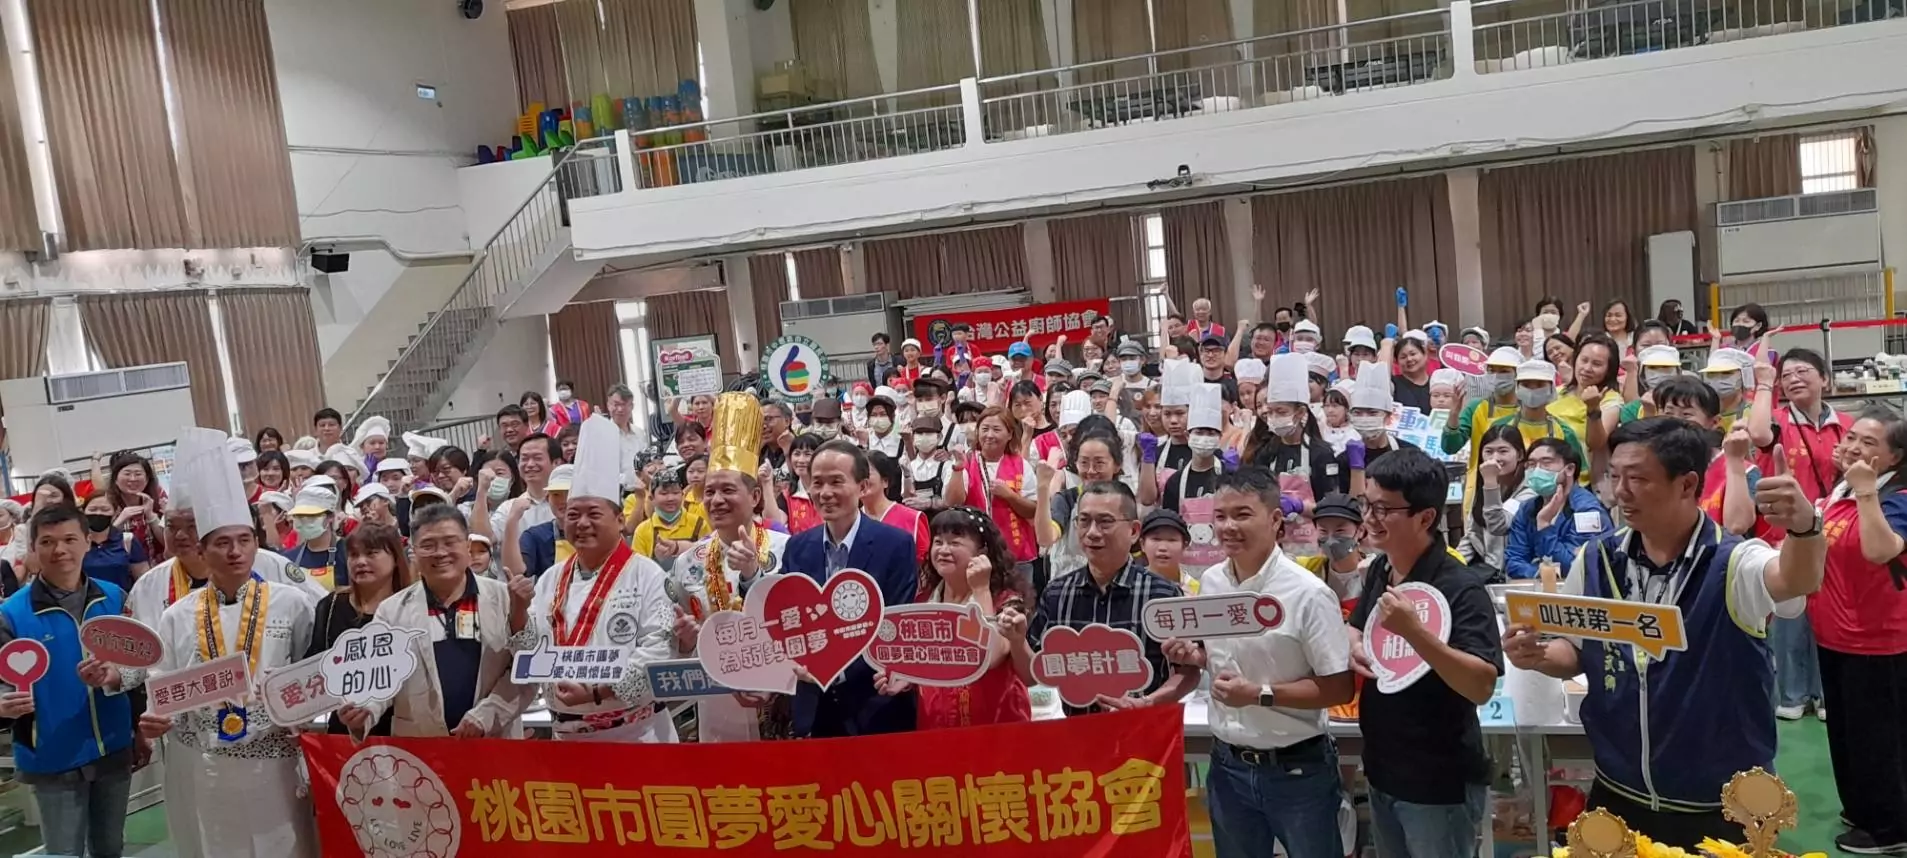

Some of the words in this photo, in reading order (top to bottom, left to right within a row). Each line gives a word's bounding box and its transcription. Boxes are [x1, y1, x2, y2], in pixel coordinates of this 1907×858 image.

[715, 605, 802, 646] 每月一愛
[900, 619, 953, 642] 桃園市
[1154, 602, 1250, 631] 每月一愛
[1538, 603, 1664, 640] 叫我第一名
[343, 632, 394, 663] 感恩
[719, 628, 829, 674] 為弱勢圓夢
[876, 645, 980, 665] 圓夢愛心關懷協會
[1040, 650, 1142, 677] 圓夢計畫
[155, 669, 235, 706] 愛要大聲說
[342, 665, 392, 696] 的心
[656, 668, 720, 692] 我們
[1490, 701, 1503, 720] 2
[466, 757, 1168, 849] 桃園市圓夢愛心關懷協會
[407, 821, 422, 843] LIVE
